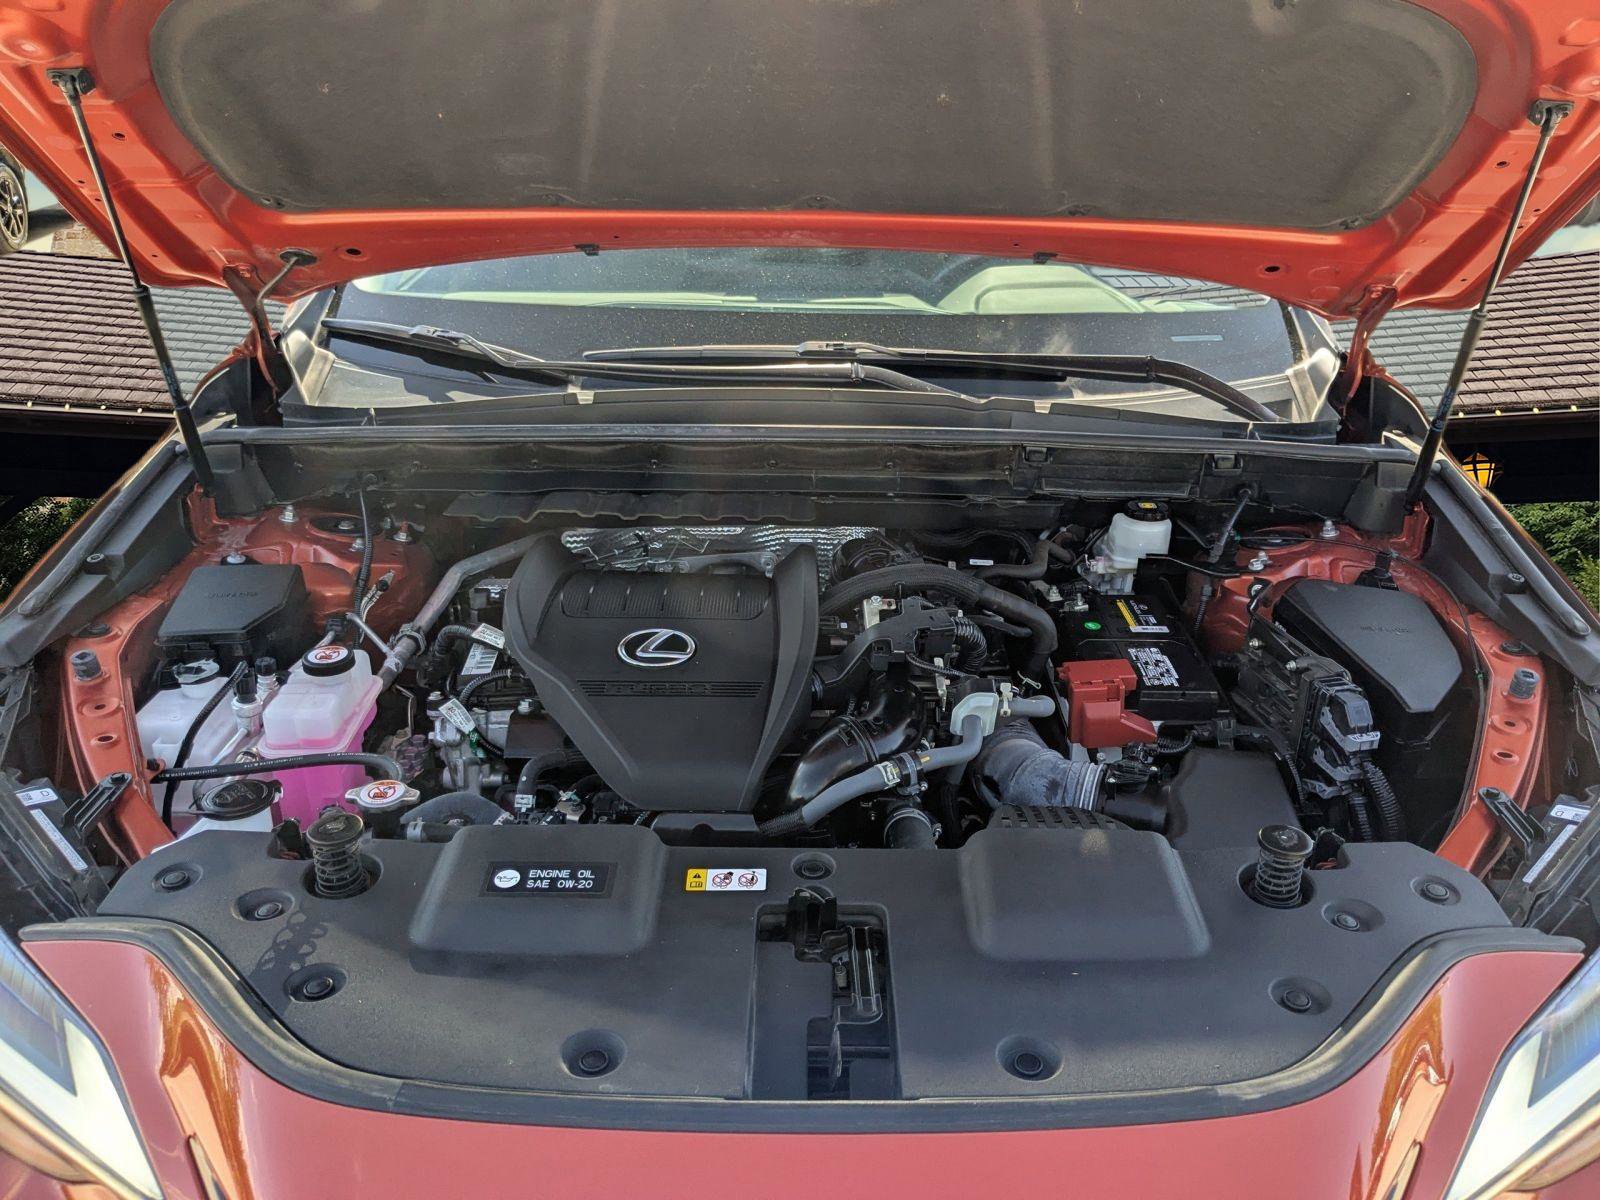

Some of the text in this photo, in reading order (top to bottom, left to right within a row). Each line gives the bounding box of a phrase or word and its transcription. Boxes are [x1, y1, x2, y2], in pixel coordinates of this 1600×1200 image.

[528, 869, 595, 878] ENGINE OIL
[526, 880, 593, 888] SAE 0W-20
